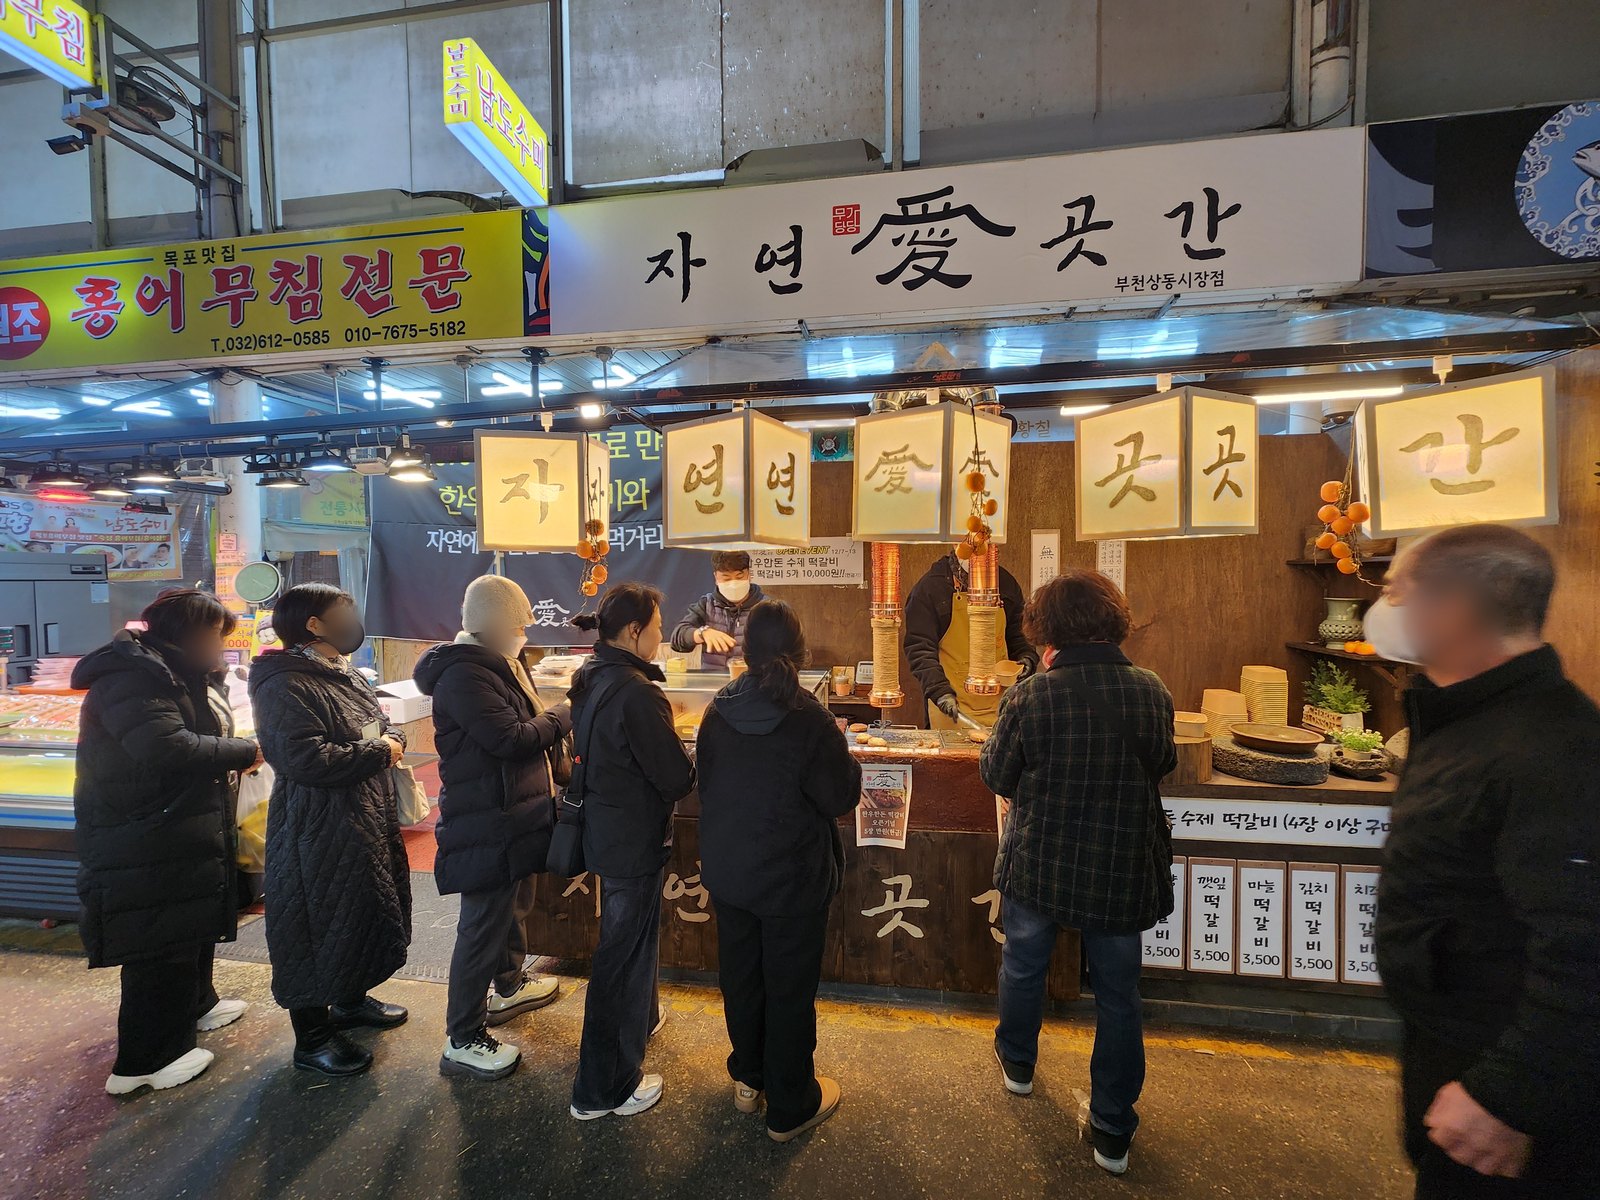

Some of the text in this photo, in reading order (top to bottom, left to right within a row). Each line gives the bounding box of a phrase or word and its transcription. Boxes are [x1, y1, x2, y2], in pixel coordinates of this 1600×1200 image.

[446, 42, 471, 119] 남도수미
[476, 64, 547, 190] 남도수미
[1114, 269, 1225, 293] 부천상동시장점
[344, 320, 467, 343] 010-7675-5182
[635, 430, 664, 460] 만
[1399, 413, 1520, 496] 간
[864, 444, 935, 495] 愛
[1095, 430, 1163, 509] 곳
[1202, 425, 1246, 502] 곳
[500, 458, 565, 525] 자
[683, 444, 724, 514] 연
[766, 452, 795, 516] 연
[105, 516, 168, 533] 남도수미
[786, 557, 805, 568] 수제
[809, 556, 838, 568] 떡갈비
[1040, 545, 1054, 559] 無
[757, 569, 783, 579] 떡갈비
[1181, 810, 1214, 826] 수제
[1222, 812, 1278, 831] 떡갈비
[1324, 817, 1362, 835] 이상
[1197, 875, 1226, 890] 깻잎
[1247, 879, 1275, 894] 마늘
[1299, 882, 1328, 896] 김치
[861, 874, 930, 939] 곳
[1203, 894, 1221, 944] 떡갈비
[1253, 898, 1271, 948] 떡갈비
[1304, 901, 1322, 952] 떡갈비
[1144, 945, 1180, 959] 3,500
[1193, 949, 1230, 963] 3,500
[1242, 953, 1280, 967] 3,500
[1294, 957, 1333, 971] 3,500
